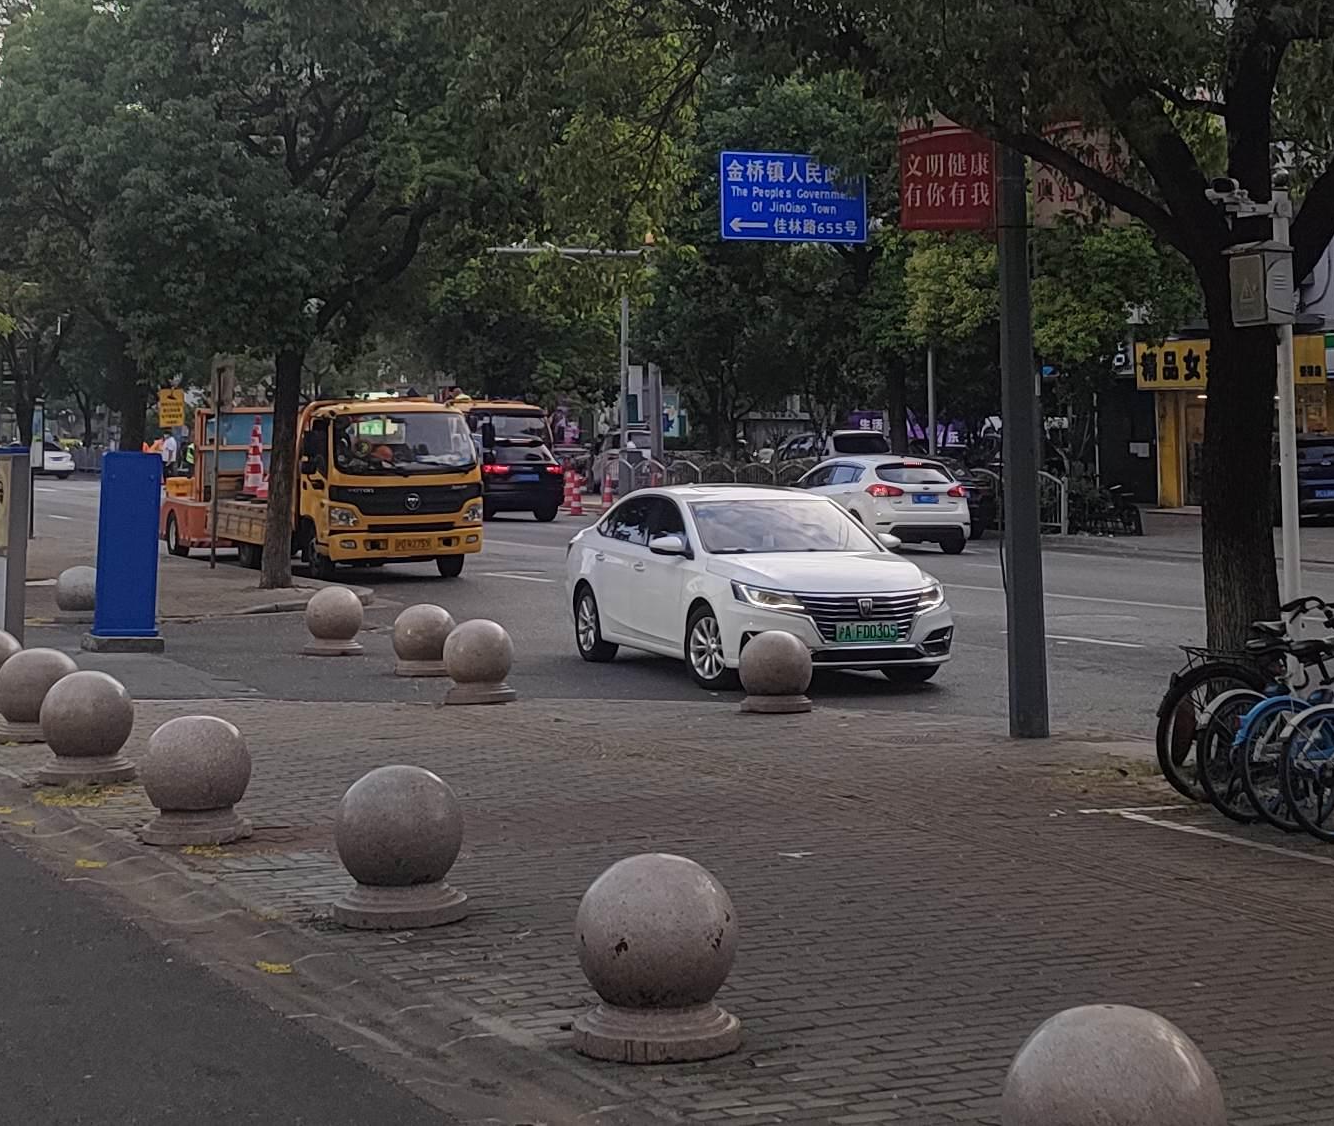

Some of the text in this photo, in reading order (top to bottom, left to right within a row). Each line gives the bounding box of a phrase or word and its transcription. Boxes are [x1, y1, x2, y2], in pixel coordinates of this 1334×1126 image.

[905, 152, 989, 177] 文明健康
[731, 186, 748, 197] The
[752, 186, 792, 200] People's
[904, 181, 990, 207] 有你有我
[751, 202, 837, 215] Of JinQiao Town
[774, 217, 858, 236] 佳林路655号
[1138, 349, 1210, 382] 精品女
